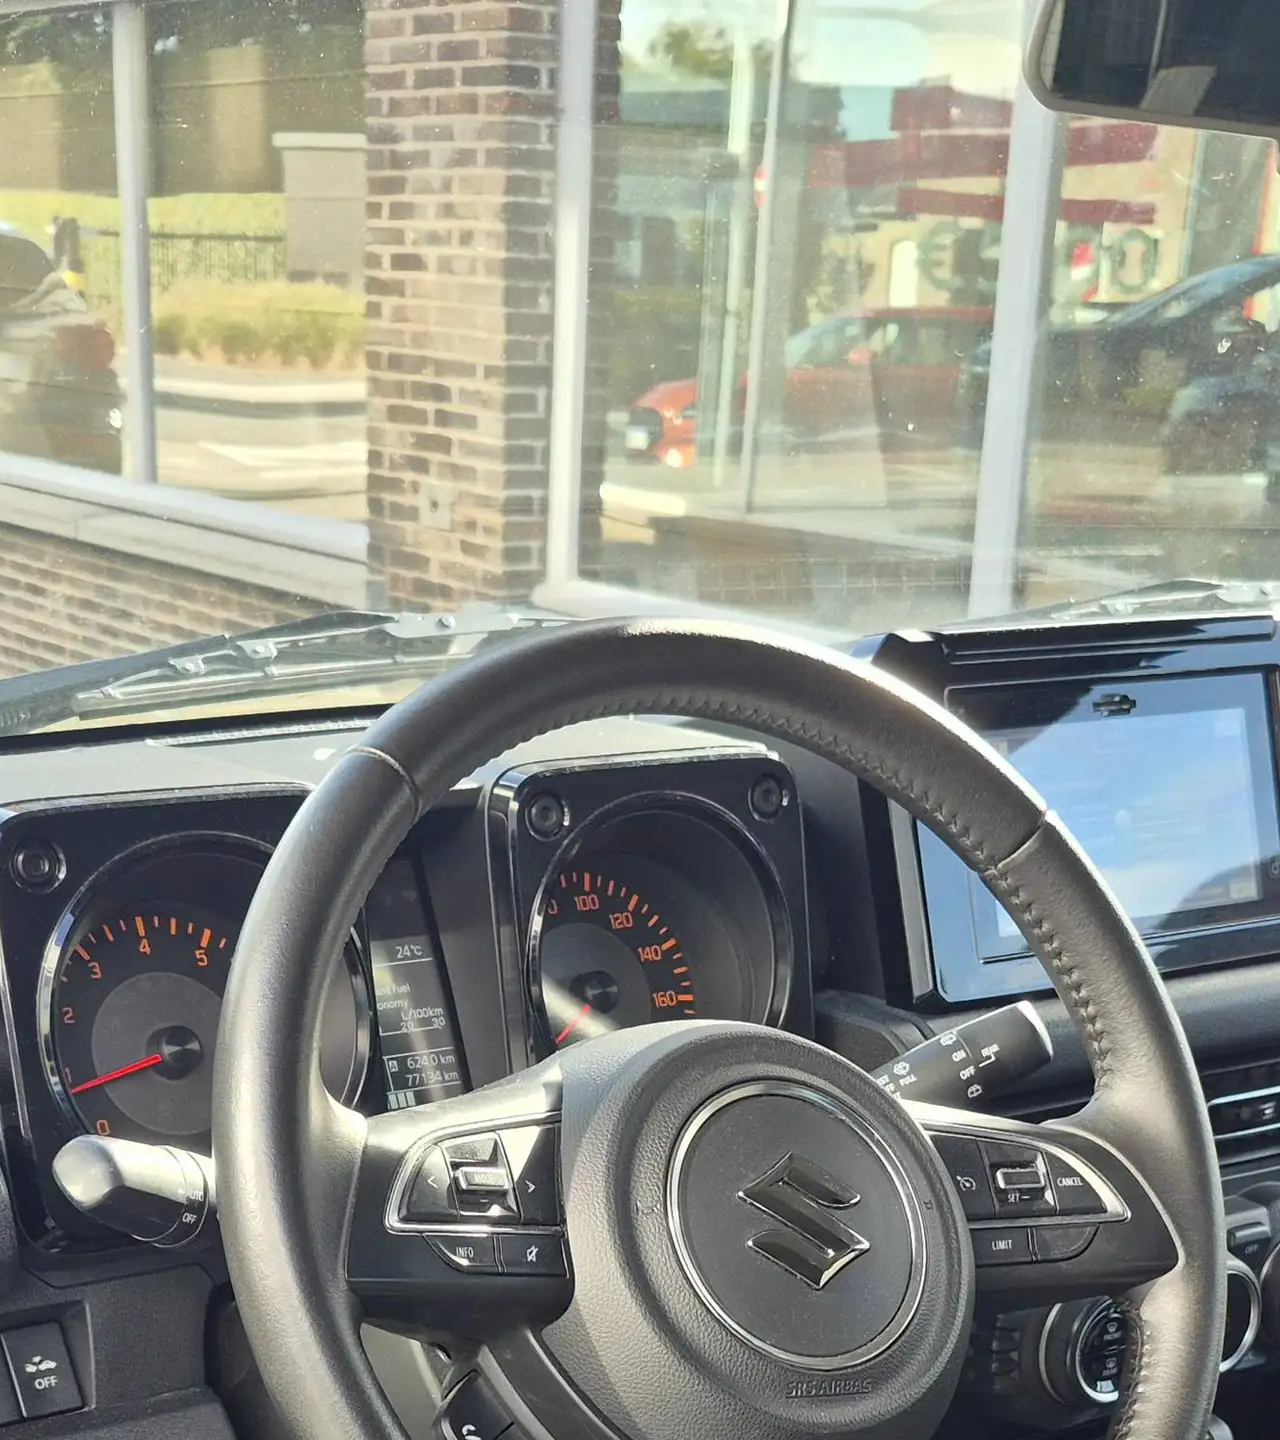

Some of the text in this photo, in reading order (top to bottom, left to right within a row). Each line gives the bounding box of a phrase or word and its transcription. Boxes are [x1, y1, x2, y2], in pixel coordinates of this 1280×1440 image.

[573, 894, 600, 911] 100
[609, 911, 634, 930] 120
[138, 938, 151, 956] 4
[395, 944, 423, 959] 24°C
[637, 944, 663, 962] 140
[194, 949, 209, 967] 5
[88, 962, 102, 979] 3
[652, 990, 677, 1008] 160
[61, 1007, 76, 1024] 2
[401, 1006, 444, 1021] L/100km
[440, 1053, 455, 1065] km
[951, 1049, 968, 1062] ON
[443, 1070, 459, 1081] km
[959, 1065, 976, 1081] OFF
[96, 1119, 111, 1136] 0
[1056, 1176, 1083, 1187] CANCEL
[1007, 1193, 1020, 1203] SET
[182, 1212, 198, 1225] OFF
[456, 1246, 474, 1259] INFO
[991, 1239, 1013, 1251] LIMIT
[1244, 1243, 1259, 1255] OFF
[35, 1375, 59, 1391] OFF
